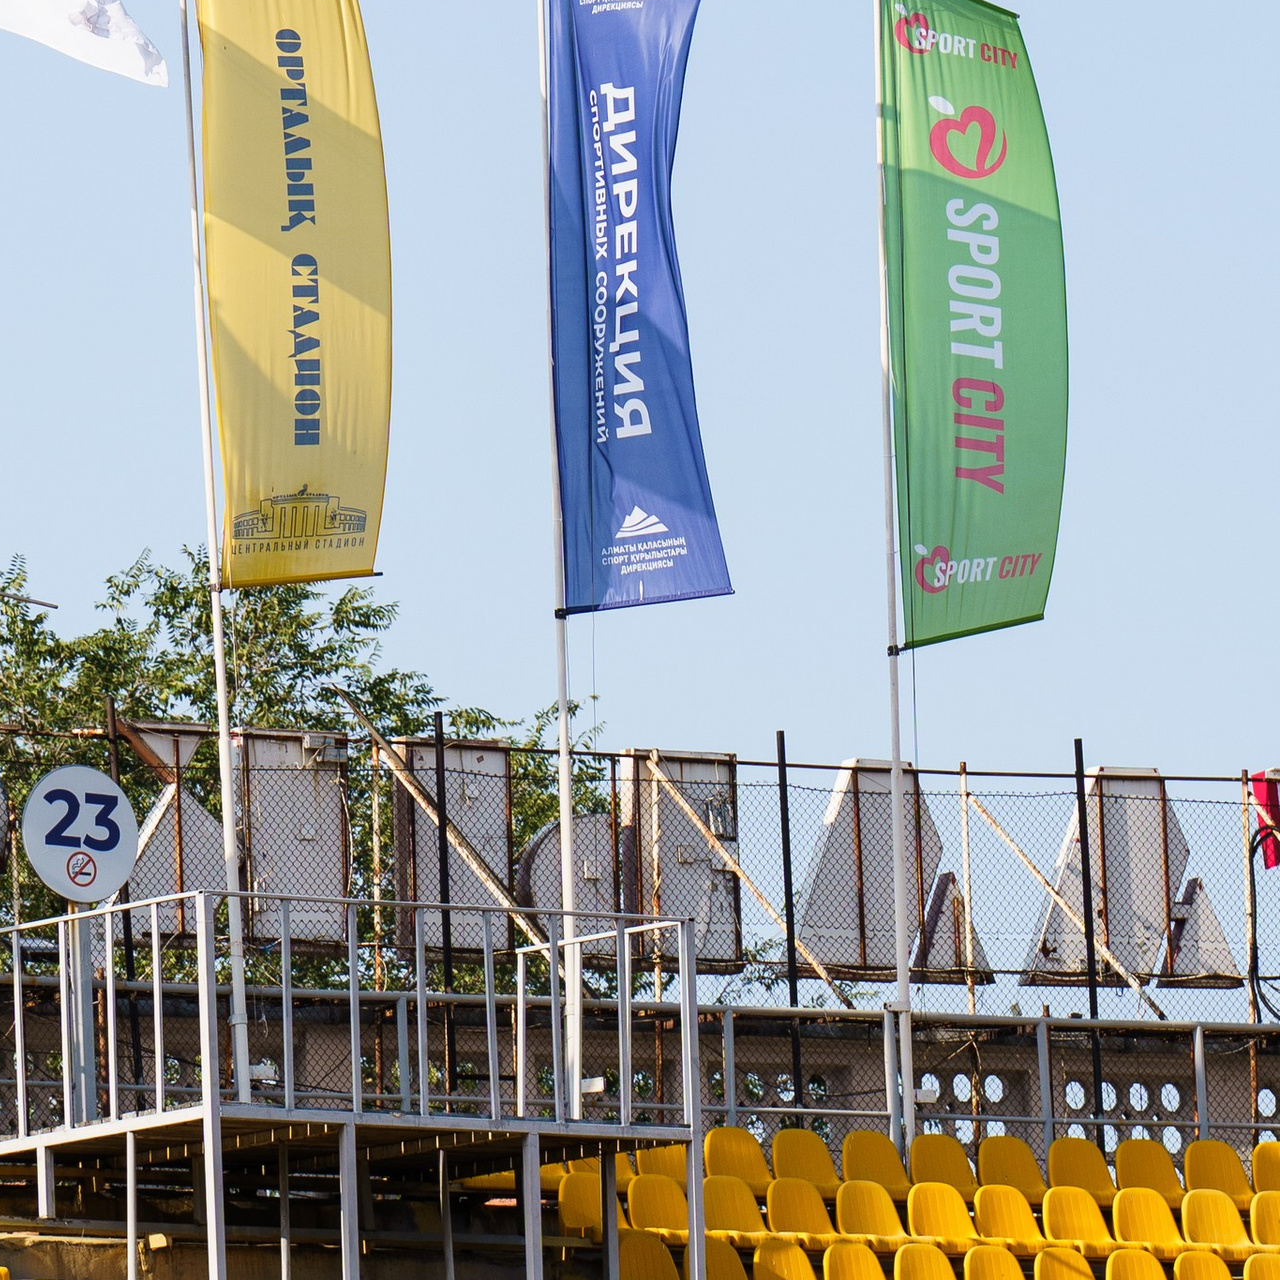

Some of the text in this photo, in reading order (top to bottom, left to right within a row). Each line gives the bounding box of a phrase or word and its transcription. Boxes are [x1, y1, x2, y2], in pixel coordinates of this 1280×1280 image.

[591, 1, 644, 15] ДИРЕКЦИЯСЫ
[914, 27, 1018, 70] SPORT CITY
[275, 28, 321, 446] ОРТАЛЫҚ СТАДИОН
[589, 89, 609, 443] СПОРТИВНЫХ СООРУЖЕНИЙ
[600, 82, 652, 439] ДИРЕКЦИЯ
[945, 198, 1005, 495] SPORT CITY
[231, 536, 366, 555] ЦЕНТРАЛЬНЫЙ СТАДИОН
[601, 543, 637, 555] АЛМАТЫ
[601, 554, 629, 565] СПОРТ
[620, 558, 674, 575] ДИРЕКЦИЯСЫ
[933, 552, 1043, 587] SPORT CITY
[43, 788, 121, 852] 23
